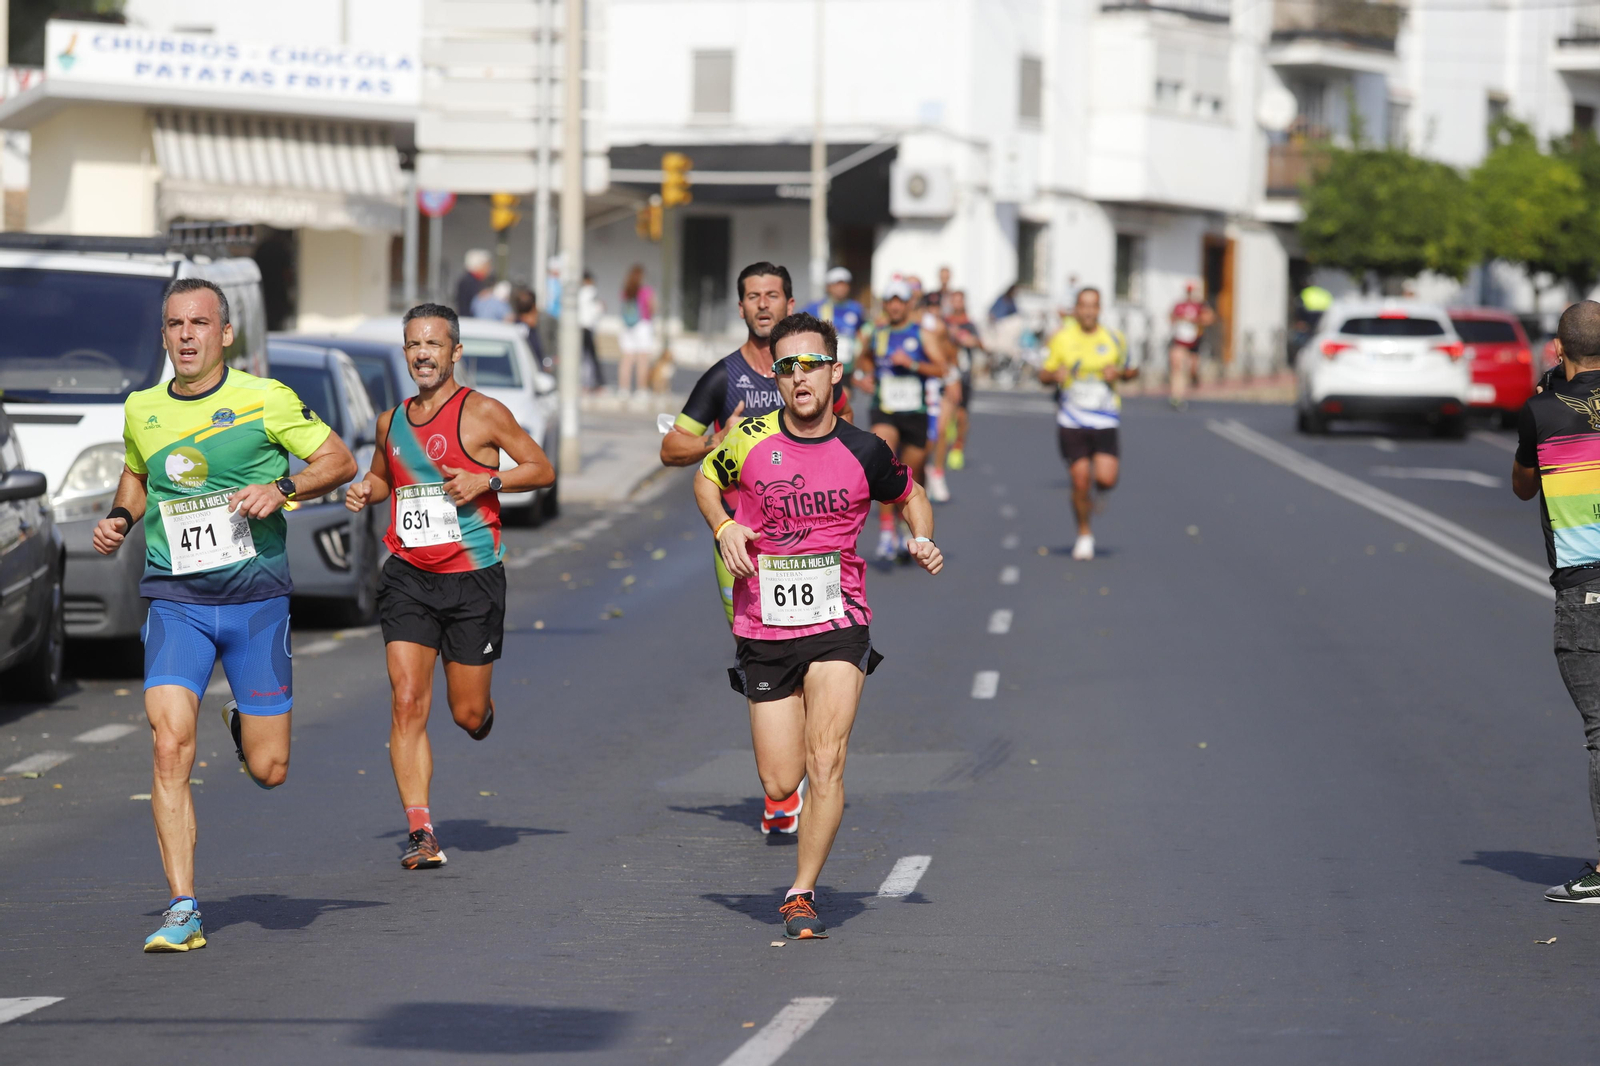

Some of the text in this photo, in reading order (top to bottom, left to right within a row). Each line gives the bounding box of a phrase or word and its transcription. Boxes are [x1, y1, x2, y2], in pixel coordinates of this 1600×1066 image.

[92, 36, 239, 58] CHURROS
[134, 62, 392, 94] PATATAS FRITAS
[421, 487, 426, 496] A
[166, 504, 174, 515] 34
[173, 500, 199, 514] VUELTA
[199, 498, 206, 509] A
[780, 488, 850, 518] TIGRES
[185, 510, 212, 520] ANTONIO
[403, 509, 430, 530] 631
[181, 523, 217, 551] 471
[763, 555, 835, 569] 34 VUELTA A HUELVA
[773, 583, 815, 607] 618
